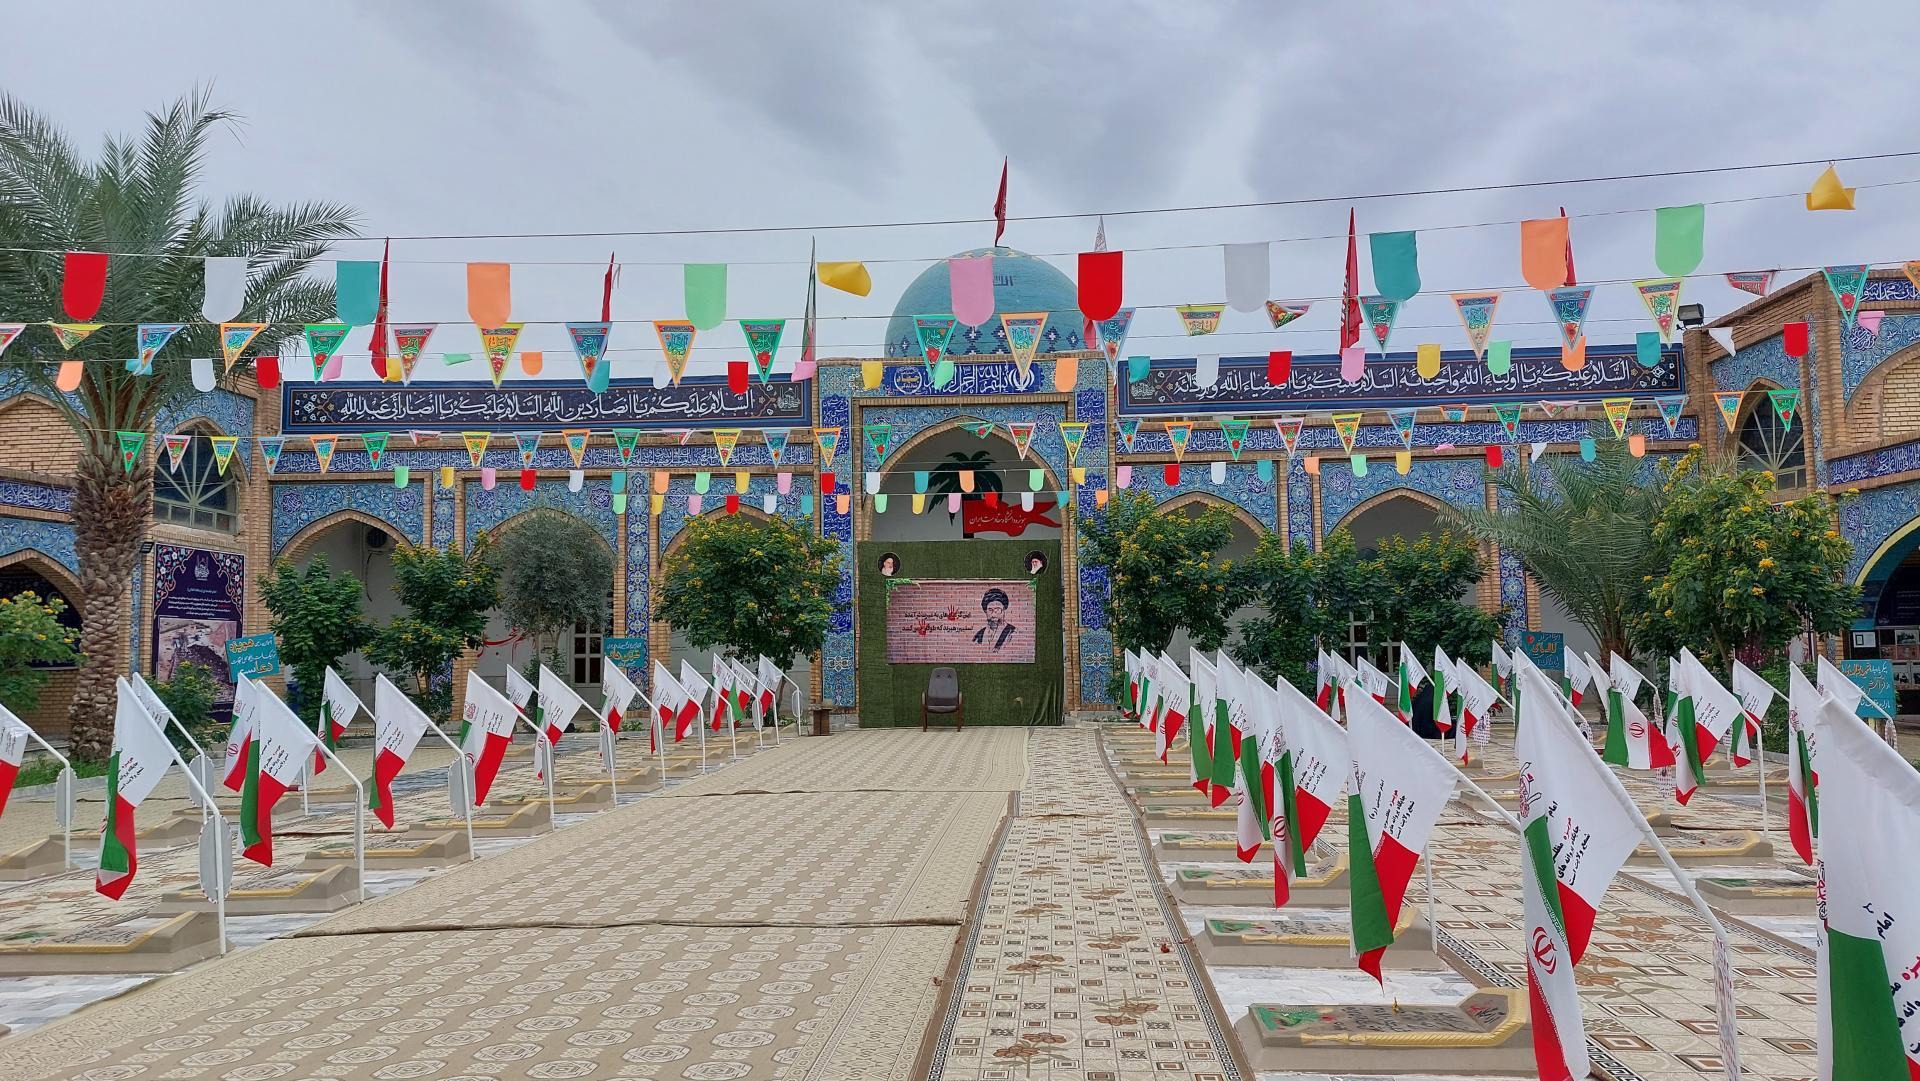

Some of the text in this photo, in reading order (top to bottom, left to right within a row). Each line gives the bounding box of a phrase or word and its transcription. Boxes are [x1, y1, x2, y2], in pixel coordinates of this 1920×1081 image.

[1548, 800, 1559, 818] امام
[1580, 833, 1592, 851] شمع
[1557, 863, 1568, 879] های
[1568, 868, 1578, 886] است
[1876, 911, 1896, 941] امام
